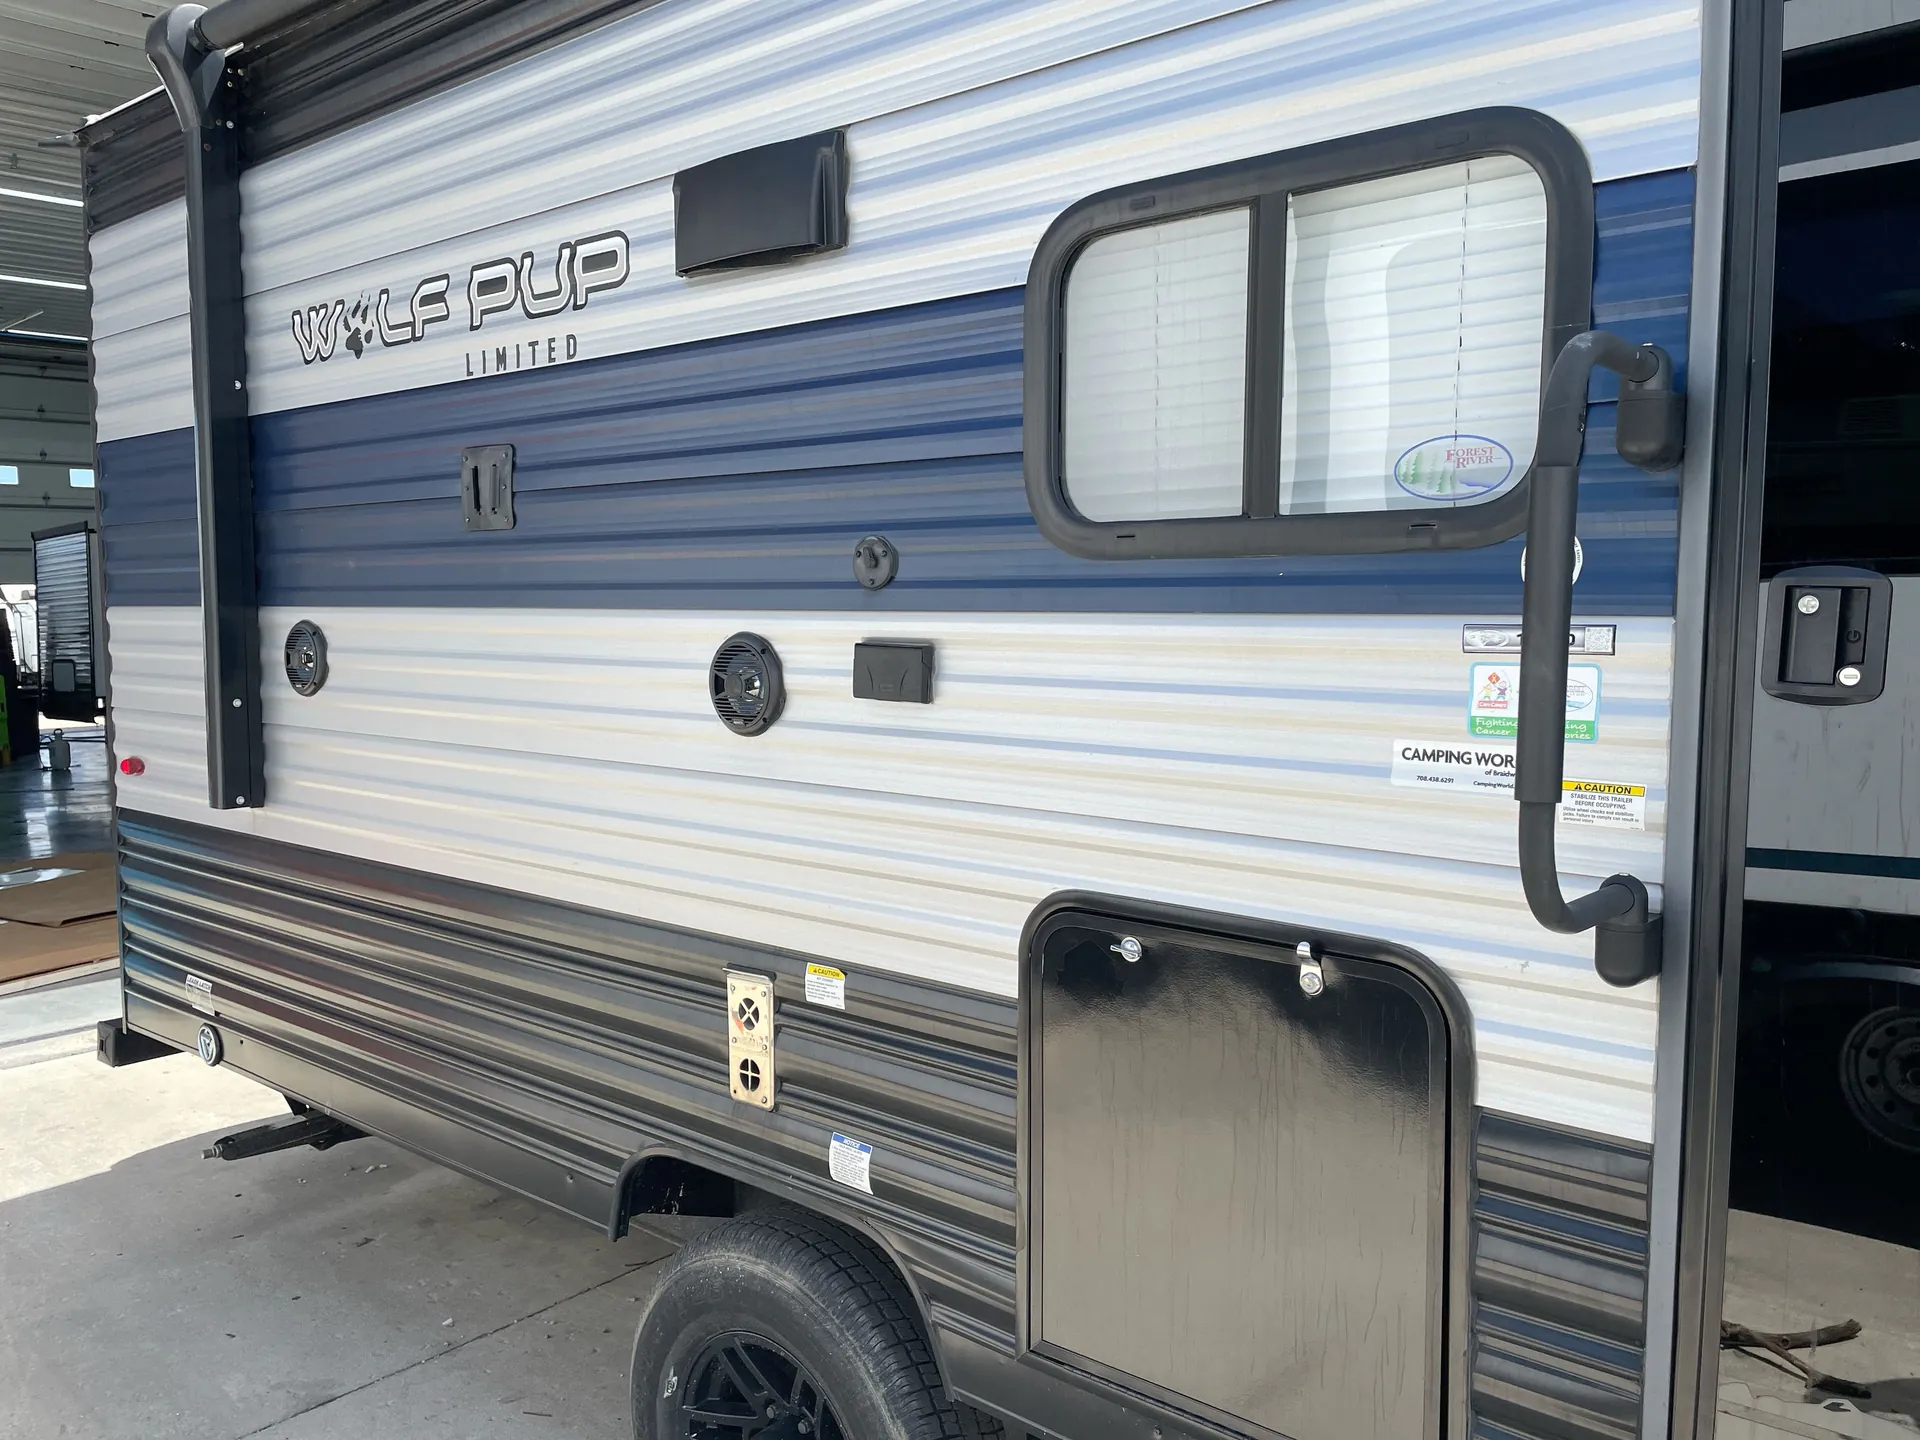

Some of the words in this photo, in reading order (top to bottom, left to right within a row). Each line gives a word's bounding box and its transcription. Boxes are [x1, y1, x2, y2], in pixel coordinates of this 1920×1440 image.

[467, 230, 630, 331] PUP
[466, 334, 578, 377] LIMITED
[1445, 446, 1496, 461] FOREST
[1456, 455, 1494, 469] RIVER
[1475, 726, 1511, 736] Cancer
[1401, 747, 1472, 765] CAMPING
[1474, 751, 1516, 769] WOR
[1584, 783, 1632, 795] CAUTION
[1570, 792, 1597, 801] STABILIZE
[1610, 796, 1633, 804] TRAILER
[817, 968, 841, 978] CAUTION
